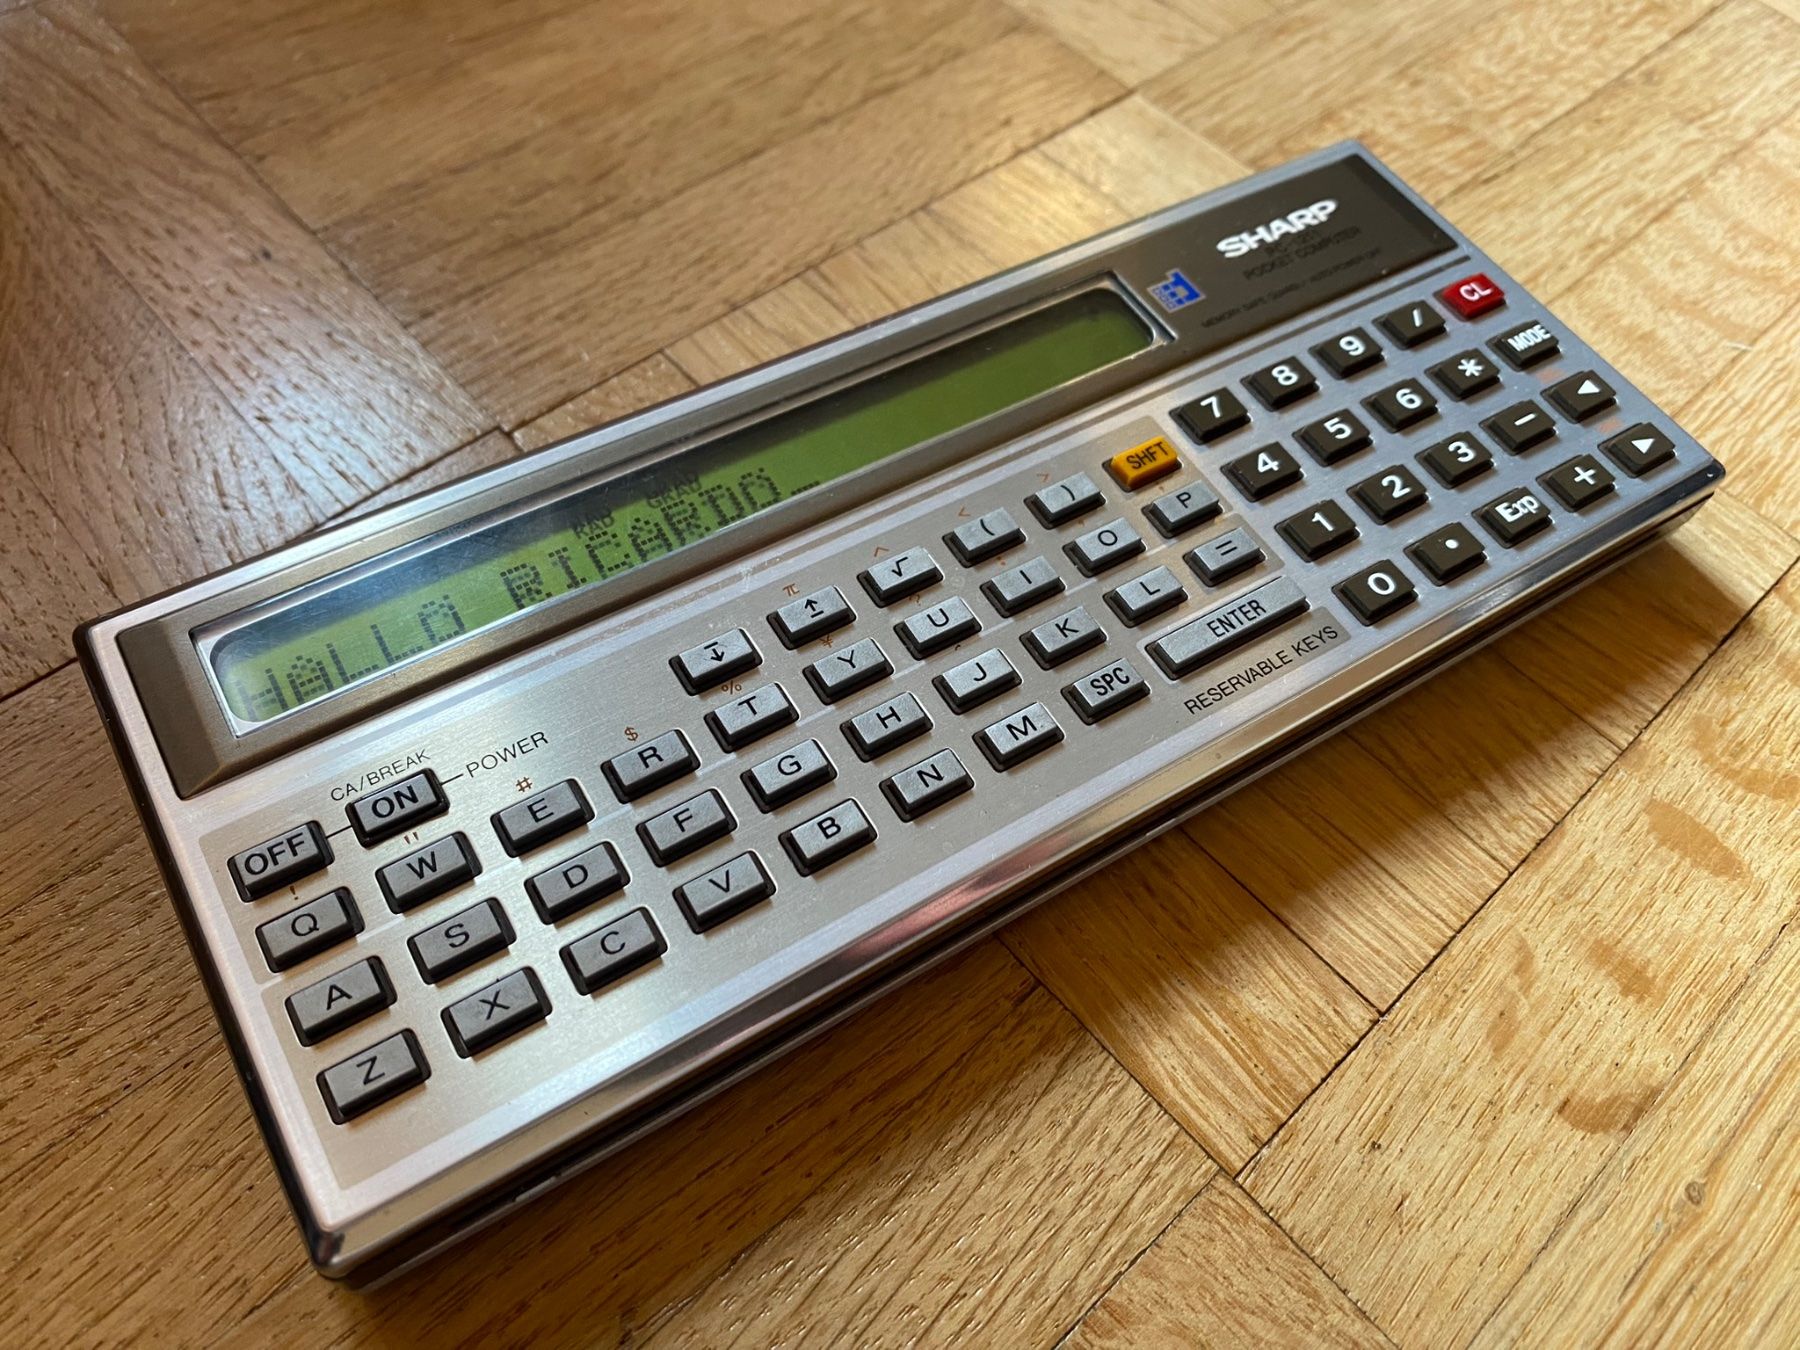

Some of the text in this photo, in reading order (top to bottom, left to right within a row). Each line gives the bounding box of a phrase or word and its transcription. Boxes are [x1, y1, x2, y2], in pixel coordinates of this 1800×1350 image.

[1216, 199, 1338, 258] SHARP
[1459, 280, 1492, 301] CL
[1339, 335, 1365, 356] 9
[1507, 324, 1551, 351] MODE
[1271, 365, 1298, 386] 8
[1200, 396, 1221, 418] 7
[1395, 388, 1422, 409] 6
[1323, 417, 1351, 439] 5
[1125, 441, 1170, 470] SHFT
[1257, 452, 1279, 473] 4
[1448, 440, 1475, 463] 3
[646, 474, 702, 510] GRAD
[1381, 474, 1412, 498] 2
[1175, 491, 1192, 508] P
[1495, 494, 1540, 523] Exp
[572, 510, 615, 539] RAD
[1311, 511, 1334, 532] 1
[1097, 529, 1118, 547] O
[1019, 569, 1033, 585] I
[1139, 580, 1161, 596] L
[1367, 572, 1396, 595] 0
[236, 467, 782, 721] HALLO RICARDO
[926, 607, 950, 628] U
[1055, 617, 1079, 639] K
[1207, 599, 1267, 638] ENTER
[837, 650, 856, 669] Y
[1183, 625, 1339, 715] RESERVABLE KEYS
[973, 662, 987, 682] J
[1090, 666, 1130, 696] SPC
[738, 695, 758, 716] T
[875, 706, 902, 729] H
[624, 726, 639, 742] $
[1006, 715, 1038, 741] M
[466, 731, 549, 778] POWER
[637, 745, 664, 769] R
[777, 754, 802, 776] G
[330, 749, 430, 801] CA/BREAK
[916, 763, 945, 788] N
[371, 785, 419, 818] ON
[527, 798, 554, 823] E
[672, 808, 694, 833] F
[817, 816, 842, 840] B
[245, 833, 305, 875] OFF
[406, 851, 438, 879] W
[562, 864, 589, 889] D
[708, 869, 731, 893] V
[291, 913, 319, 937] Q
[444, 923, 470, 948] S
[600, 930, 626, 955] C
[326, 984, 352, 1010] A
[479, 990, 510, 1020] X
[356, 1056, 385, 1085] Z
